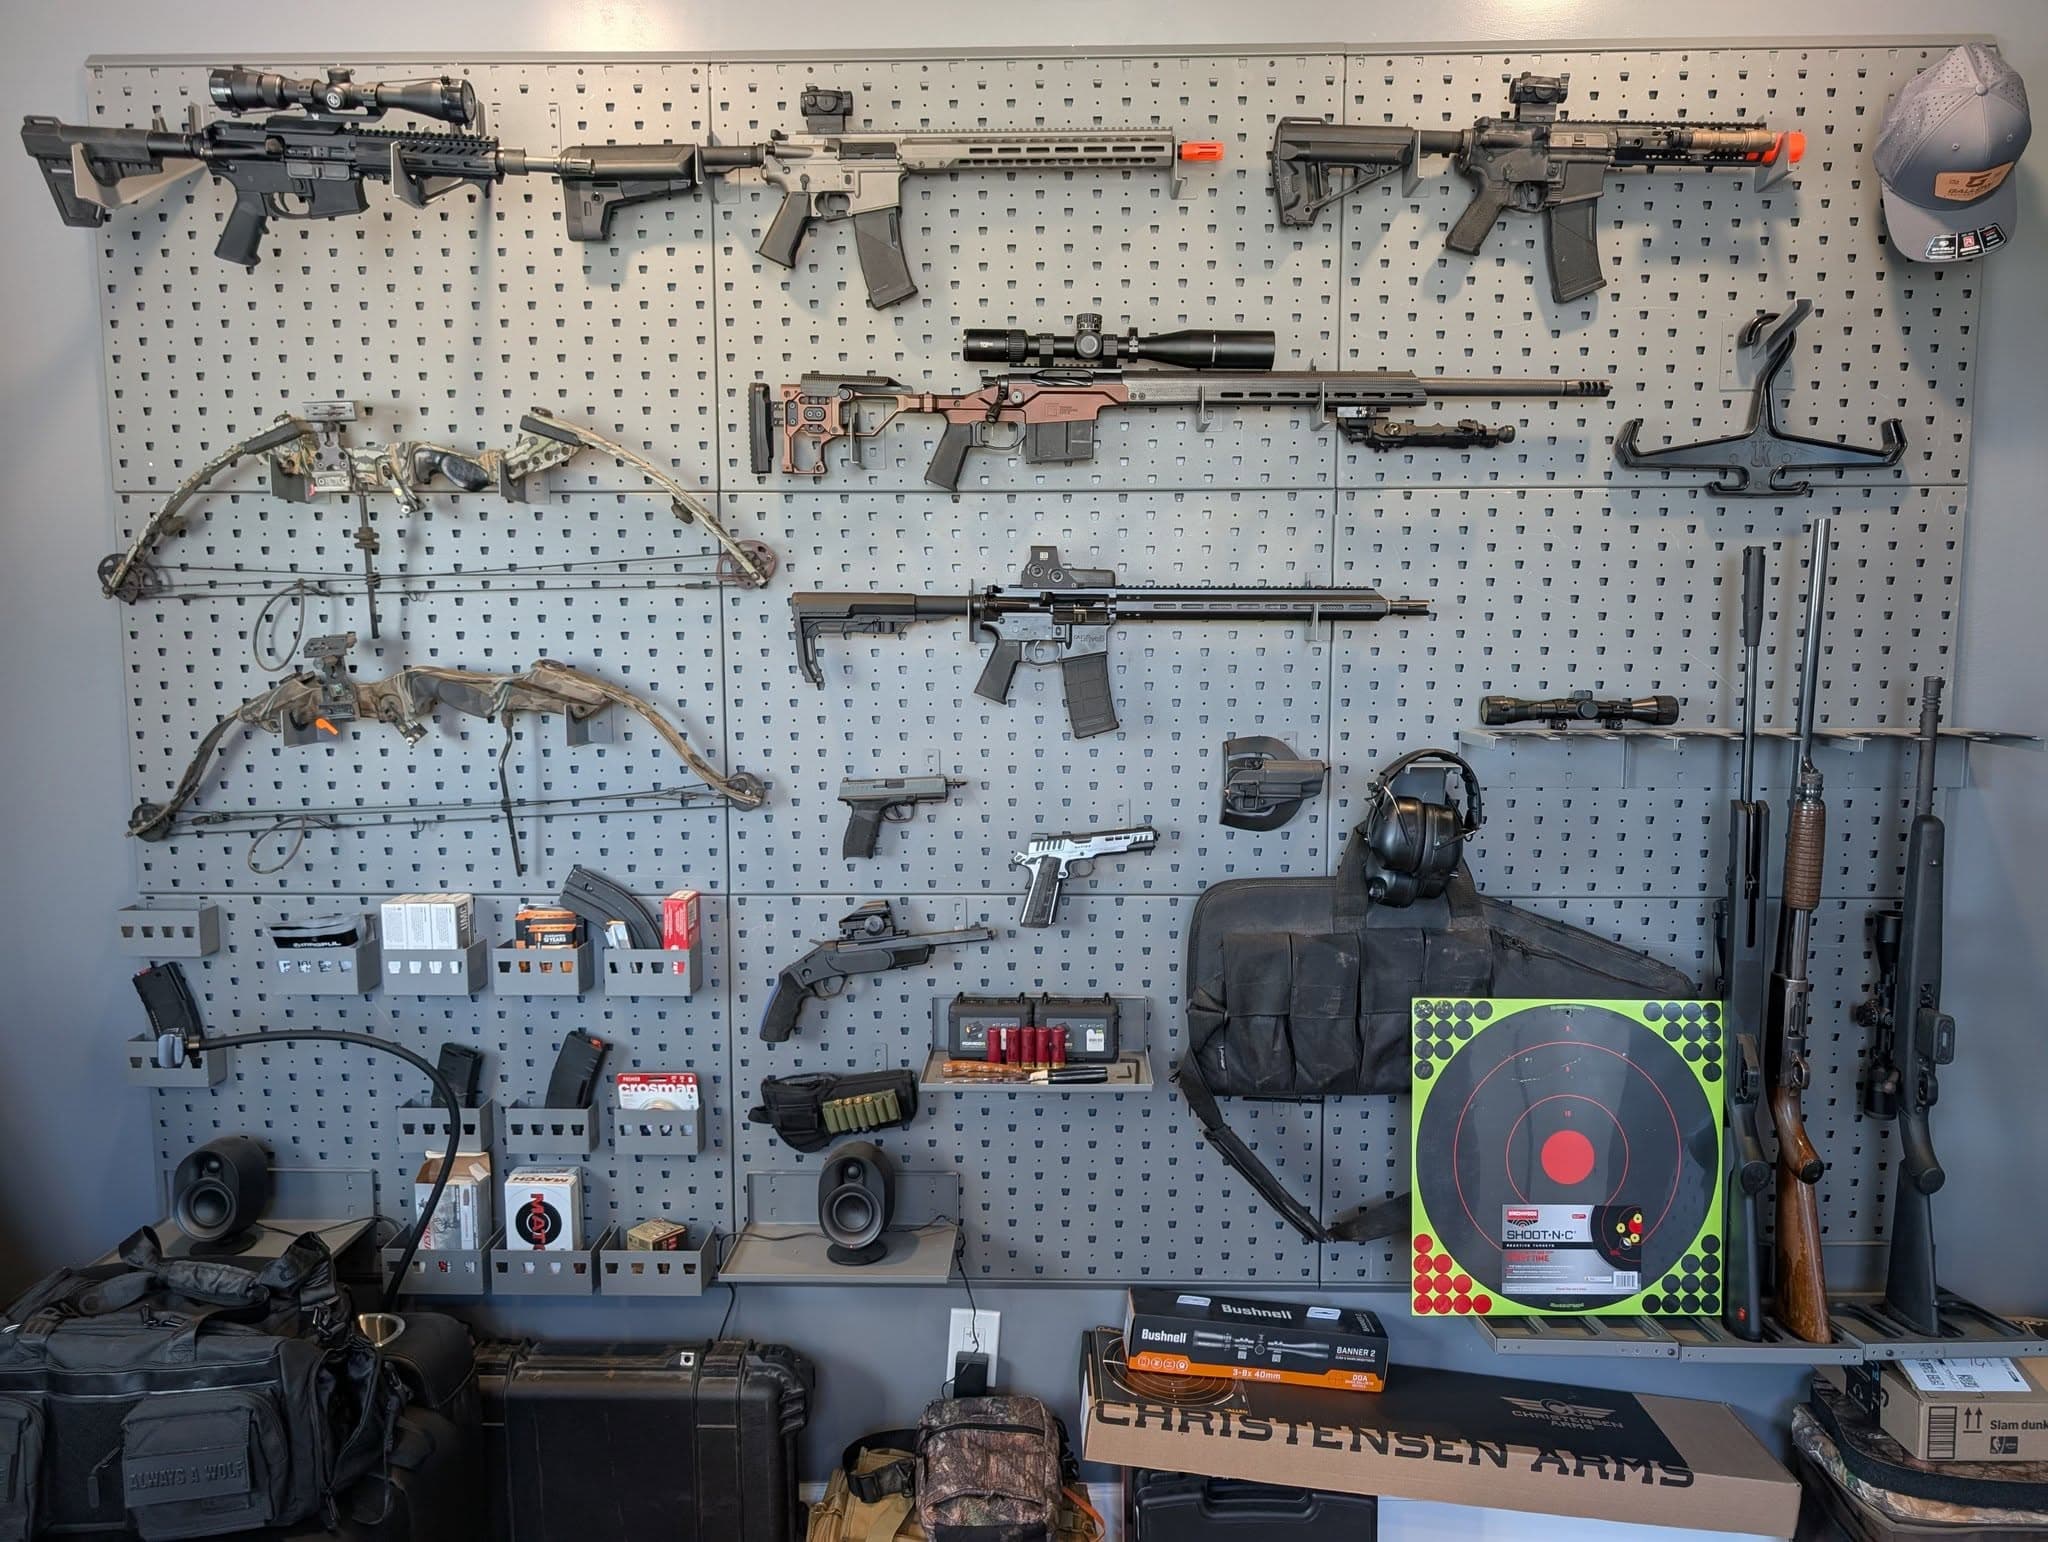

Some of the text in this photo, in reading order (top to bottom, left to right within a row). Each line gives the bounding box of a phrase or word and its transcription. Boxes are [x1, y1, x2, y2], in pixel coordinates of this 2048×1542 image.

[618, 1083, 698, 1093] crosman
[530, 1193, 546, 1250] MAT
[1221, 1304, 1292, 1320] Bushnell
[1141, 1328, 1187, 1344] Bushnell
[1336, 1346, 1376, 1357] BANNER 2
[1511, 1410, 1625, 1429] CHRISTENSEN
[1550, 1420, 1596, 1431] ARMS
[1990, 1420, 2019, 1430] Slam
[1096, 1400, 1695, 1488] CHRISTENSEN ARMS
[129, 1460, 245, 1490] ALWAYS A WOLF
